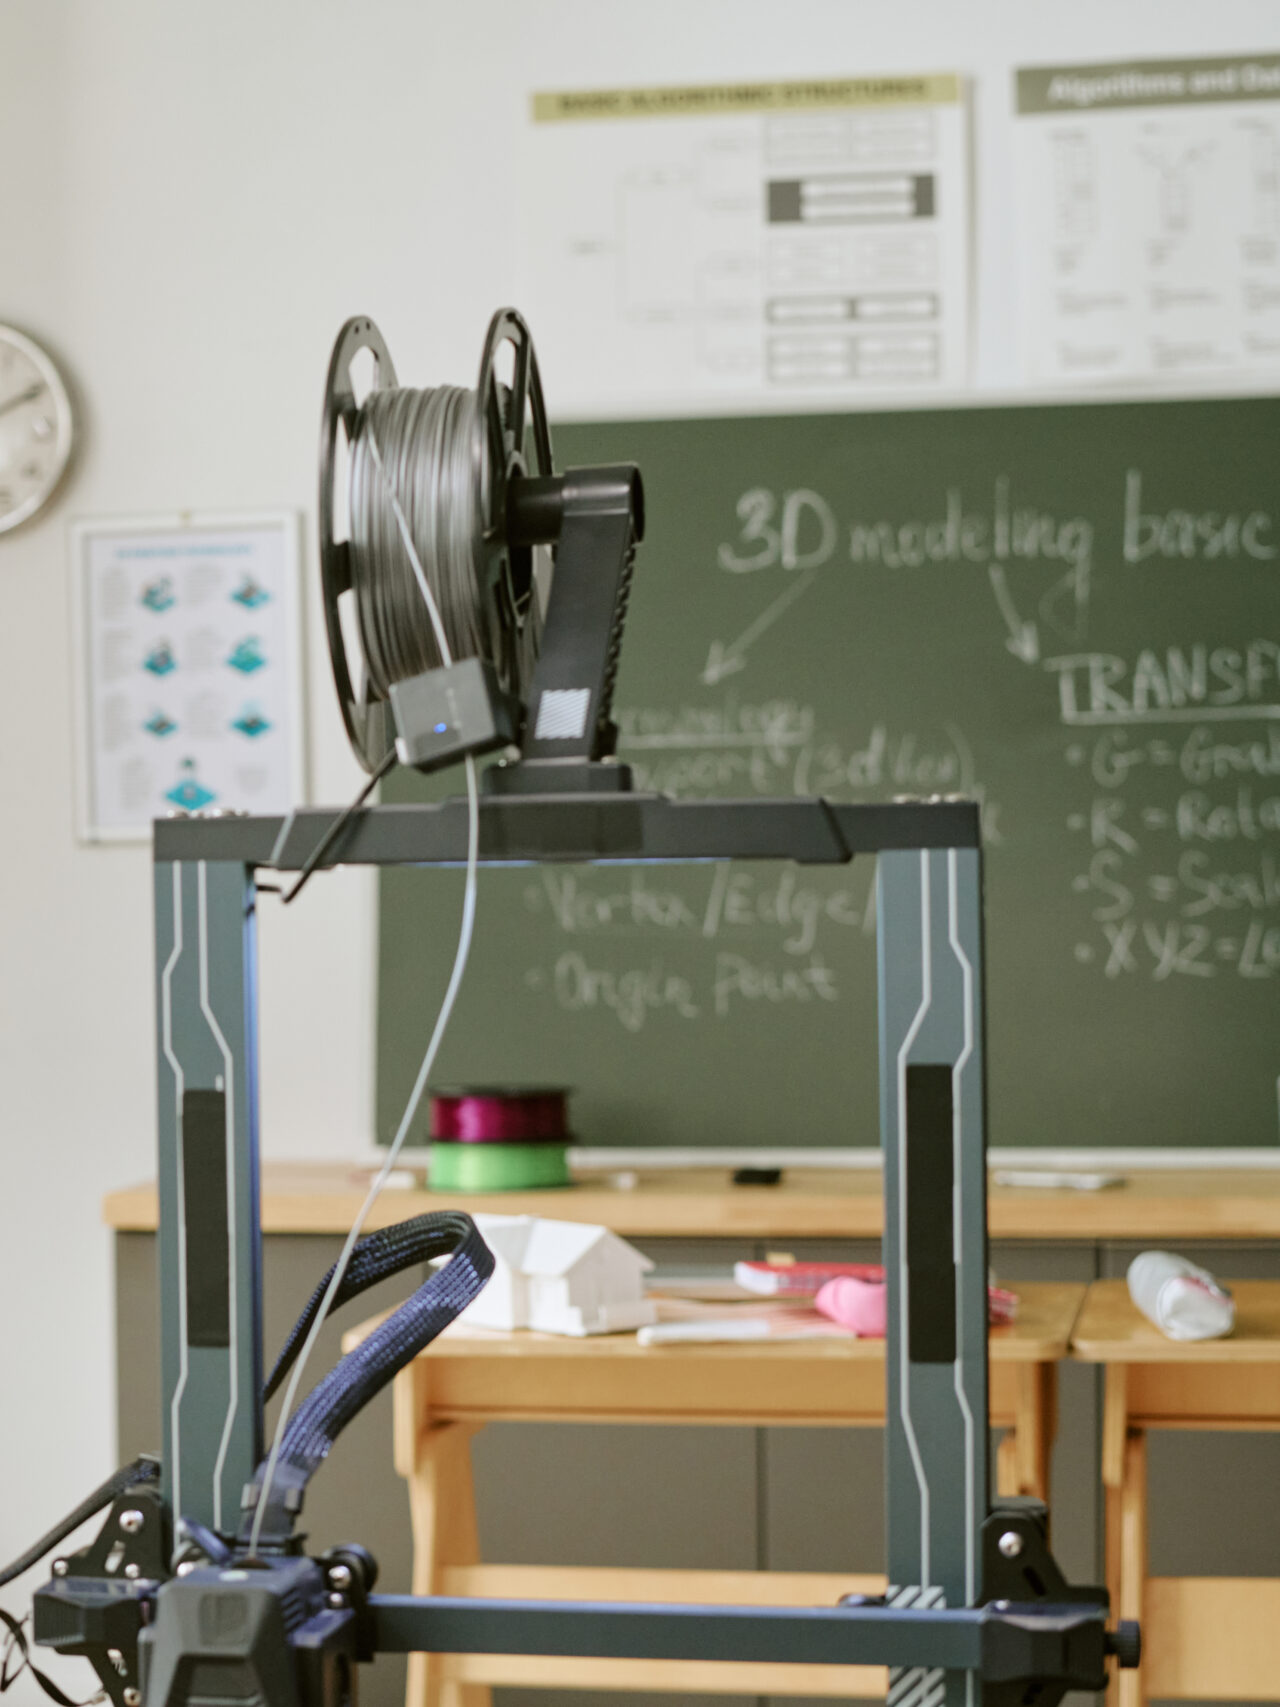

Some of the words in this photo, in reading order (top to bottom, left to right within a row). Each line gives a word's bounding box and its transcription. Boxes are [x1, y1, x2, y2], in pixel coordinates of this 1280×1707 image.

[1048, 74, 1186, 106] Algorithms
[1189, 68, 1238, 96] and
[719, 487, 837, 574] 3D
[849, 473, 1094, 642] modeling
[1123, 468, 1280, 563] basic
[1043, 638, 1280, 716] TRANSF
